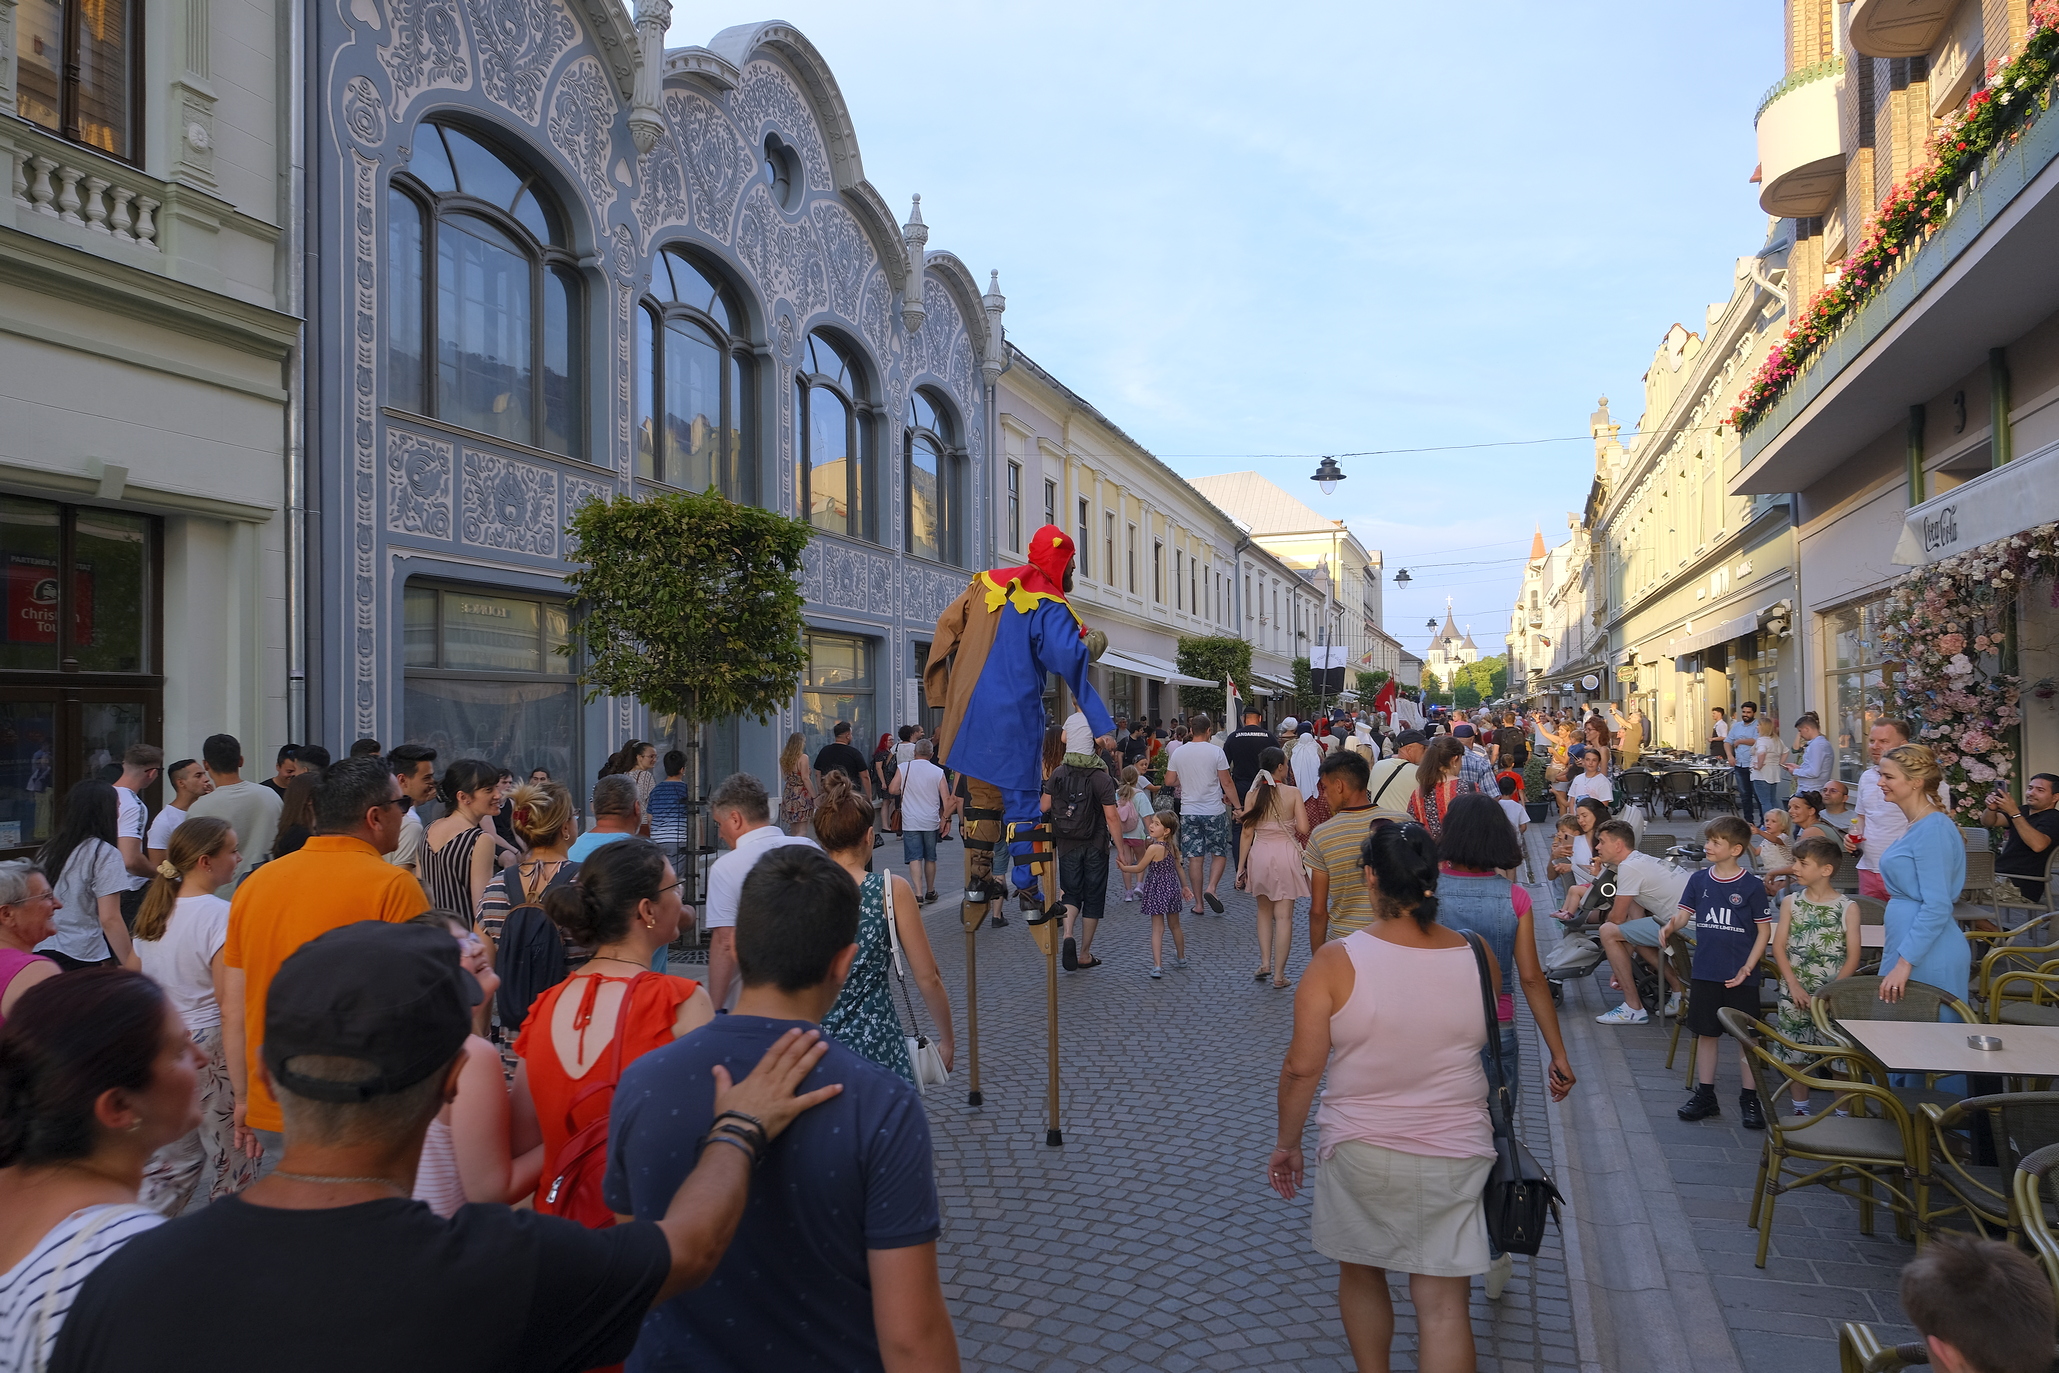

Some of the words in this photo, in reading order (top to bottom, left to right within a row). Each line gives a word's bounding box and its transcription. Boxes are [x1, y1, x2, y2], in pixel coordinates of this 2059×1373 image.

[1953, 391, 1967, 435] 3
[10, 555, 50, 566] PARTENER
[21, 607, 80, 623] Chrisn
[36, 621, 57, 633] Tou
[1720, 925, 1745, 933] LIMITLESS
